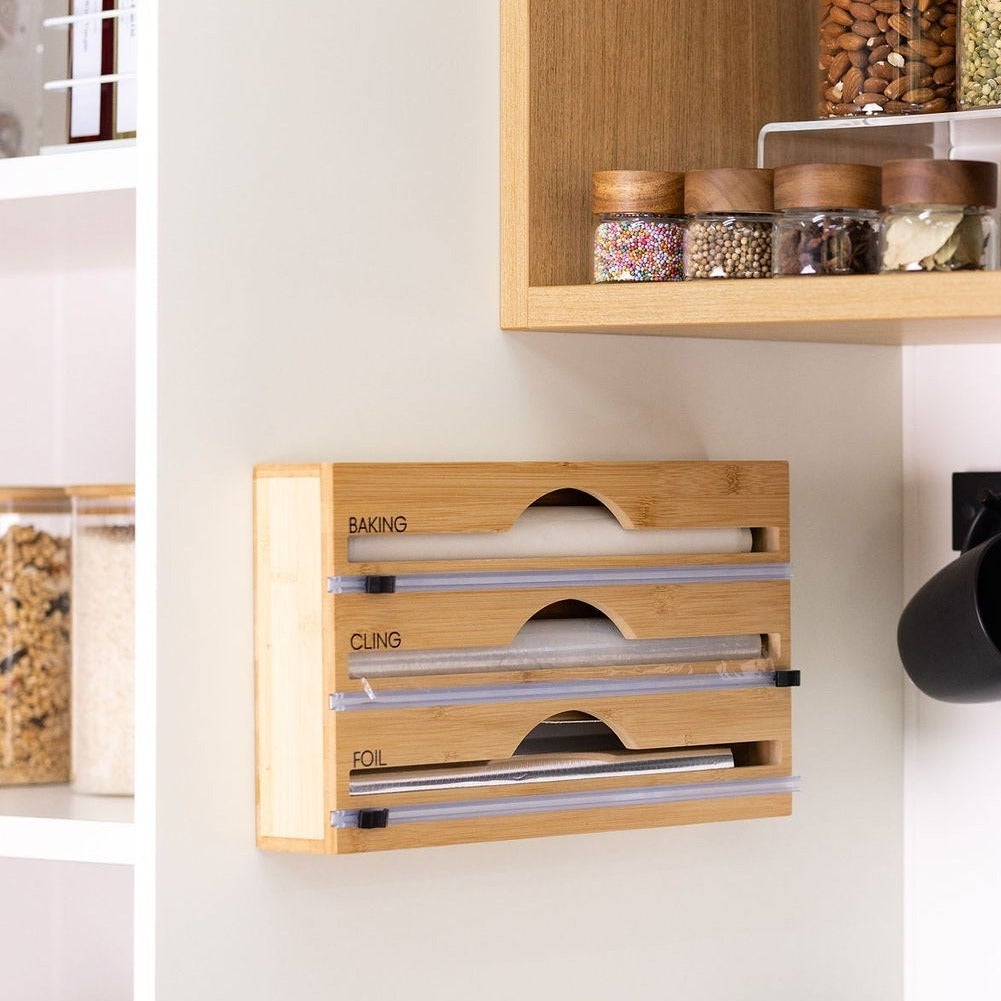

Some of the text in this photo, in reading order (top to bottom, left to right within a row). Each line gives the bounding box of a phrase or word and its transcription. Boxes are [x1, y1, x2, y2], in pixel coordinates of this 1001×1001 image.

[348, 515, 408, 534] BAKING
[350, 631, 402, 650] CLING
[353, 749, 388, 768] FOIL
